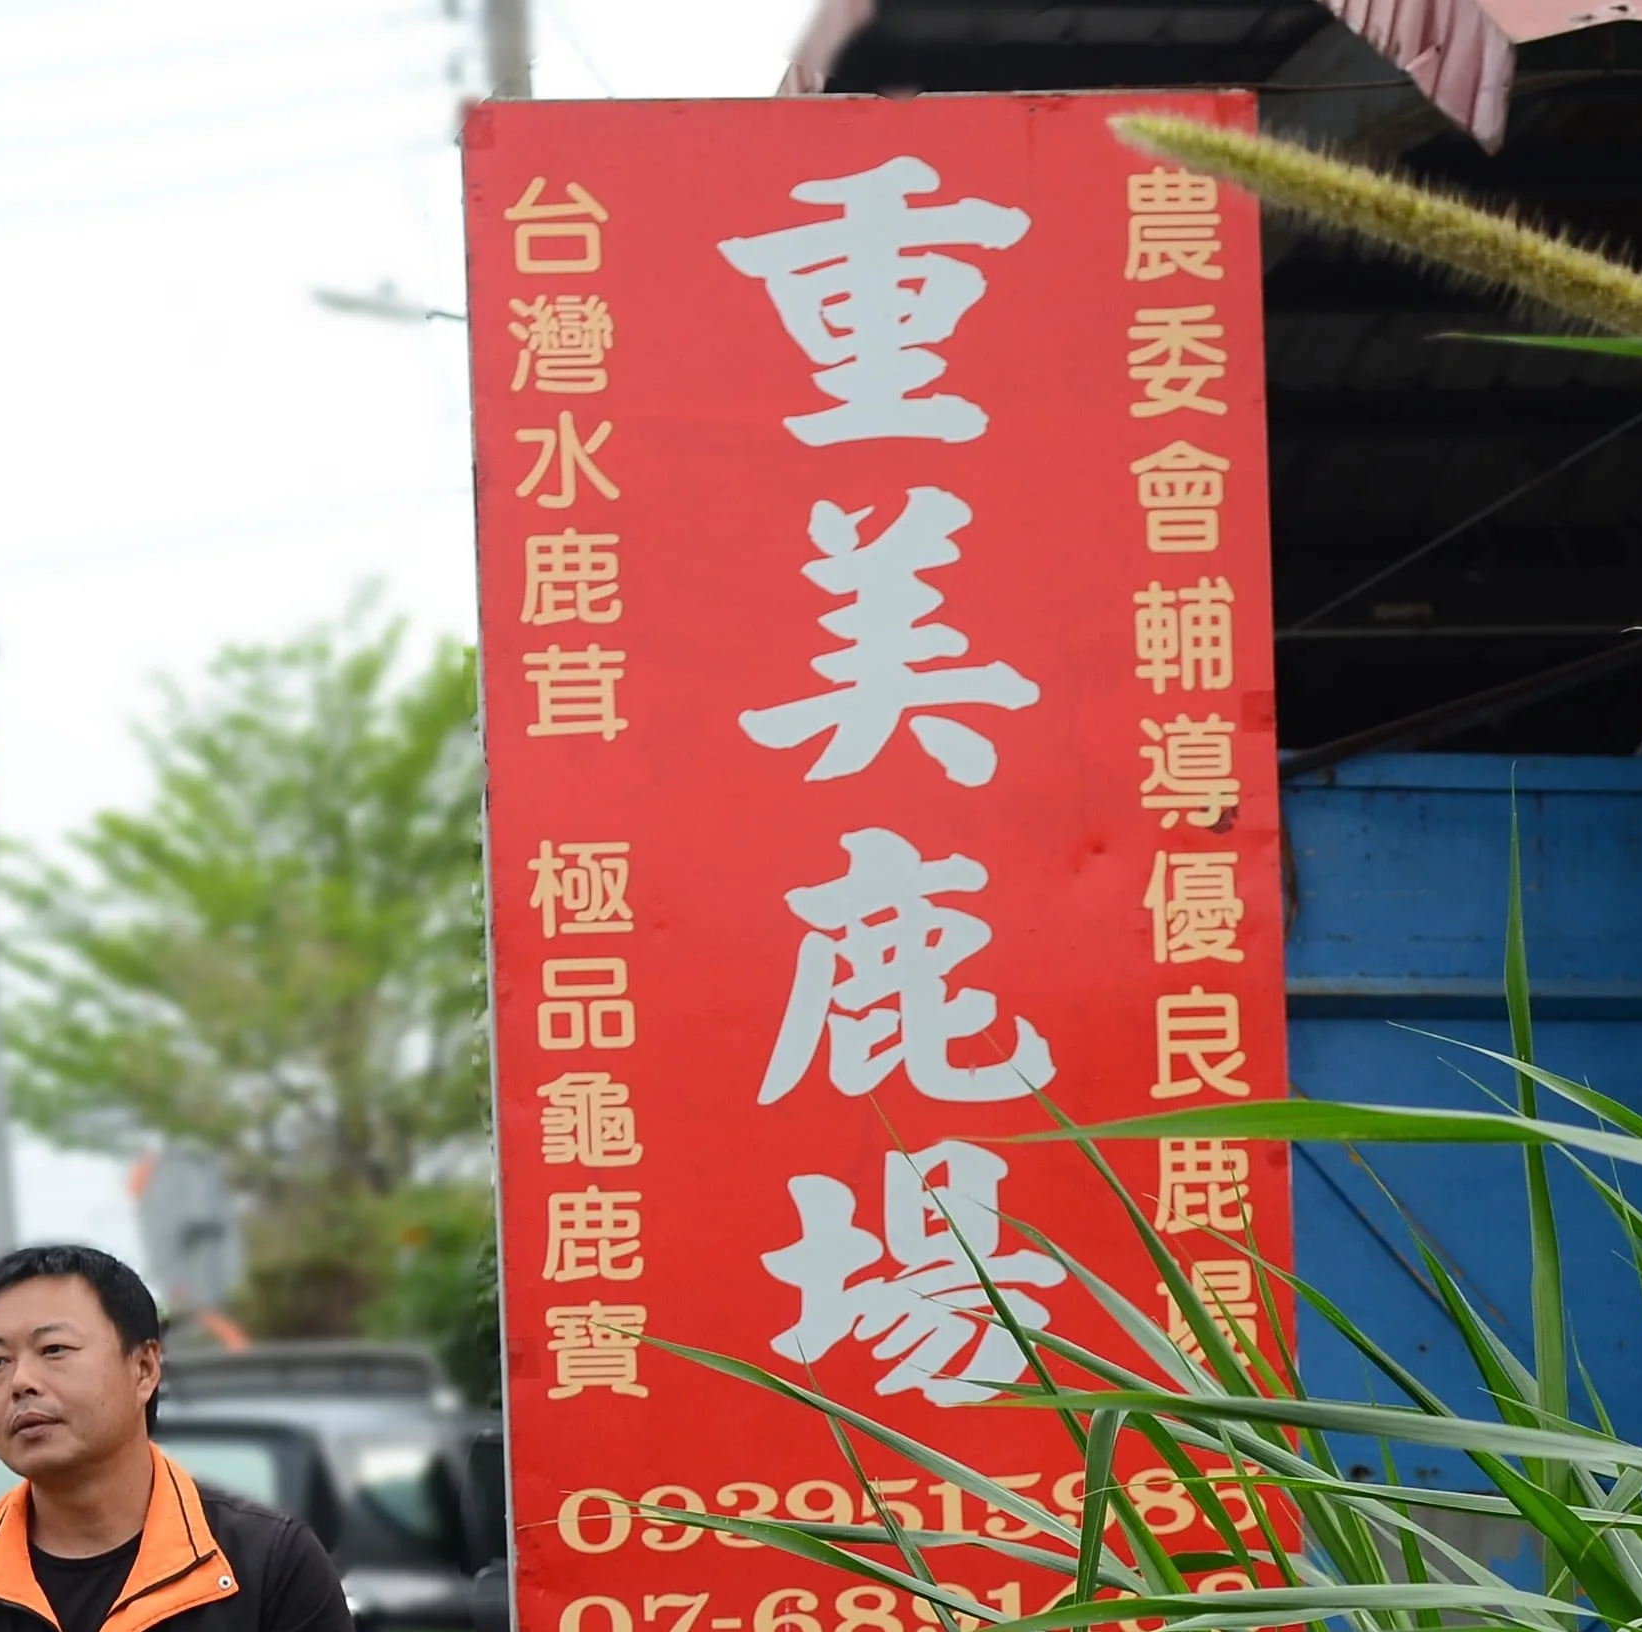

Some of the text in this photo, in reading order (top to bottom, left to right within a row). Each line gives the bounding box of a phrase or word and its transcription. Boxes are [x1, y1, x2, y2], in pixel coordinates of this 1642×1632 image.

[502, 175, 650, 1400] 台灣水鹿茸 極品龜鹿寶
[716, 154, 1068, 1408] 重美鹿場
